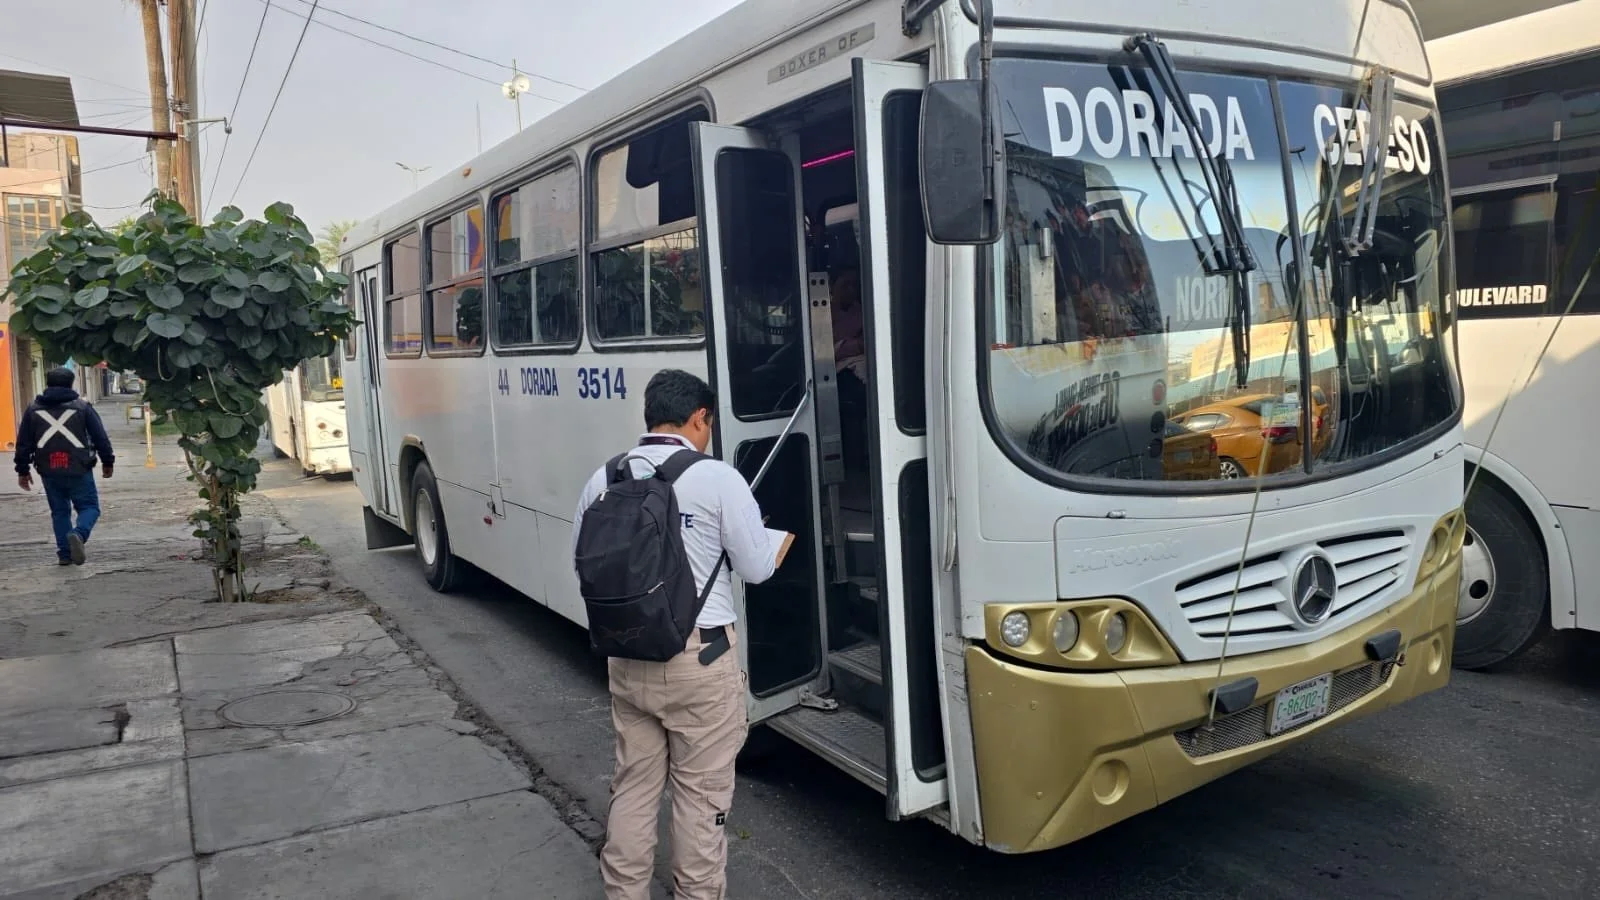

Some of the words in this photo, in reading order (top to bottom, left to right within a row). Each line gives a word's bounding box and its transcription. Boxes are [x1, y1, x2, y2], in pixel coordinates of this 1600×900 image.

[779, 47, 827, 77] BOXER
[838, 31, 858, 50] OF
[1043, 86, 1256, 161] DORADA
[1445, 284, 1547, 314] ULEVARD
[498, 368, 510, 396] 44
[520, 367, 559, 397] DORADA
[577, 366, 627, 400] 3514
